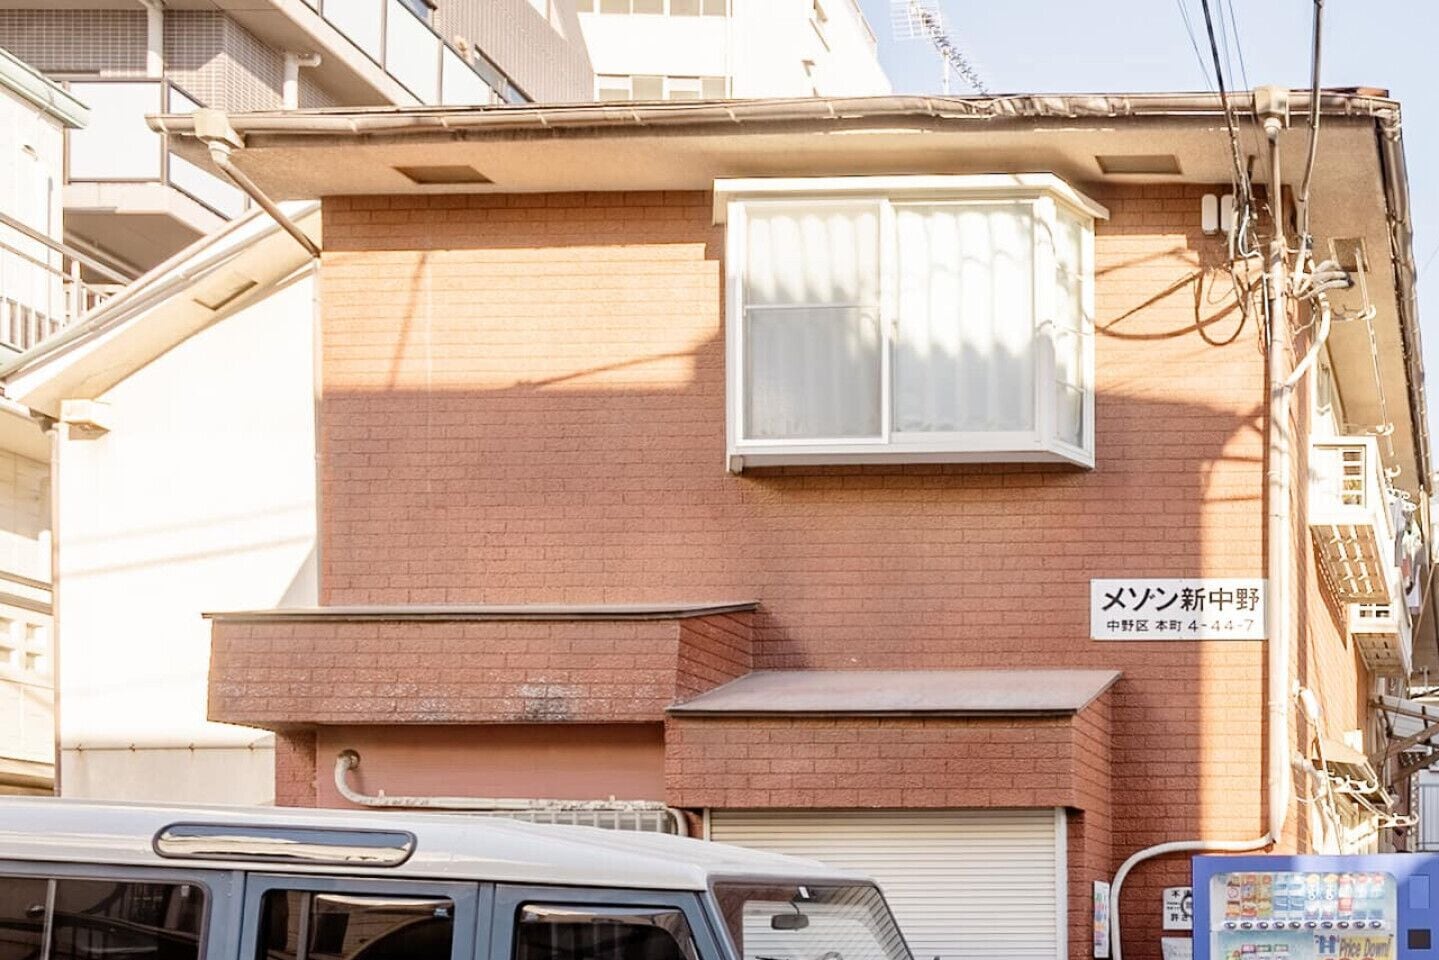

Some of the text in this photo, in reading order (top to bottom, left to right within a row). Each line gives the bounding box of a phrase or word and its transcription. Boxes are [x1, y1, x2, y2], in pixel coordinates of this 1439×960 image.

[1101, 587, 1260, 612] メゾン新中野
[1106, 619, 1254, 633] 中野区 本町 4-44-7
